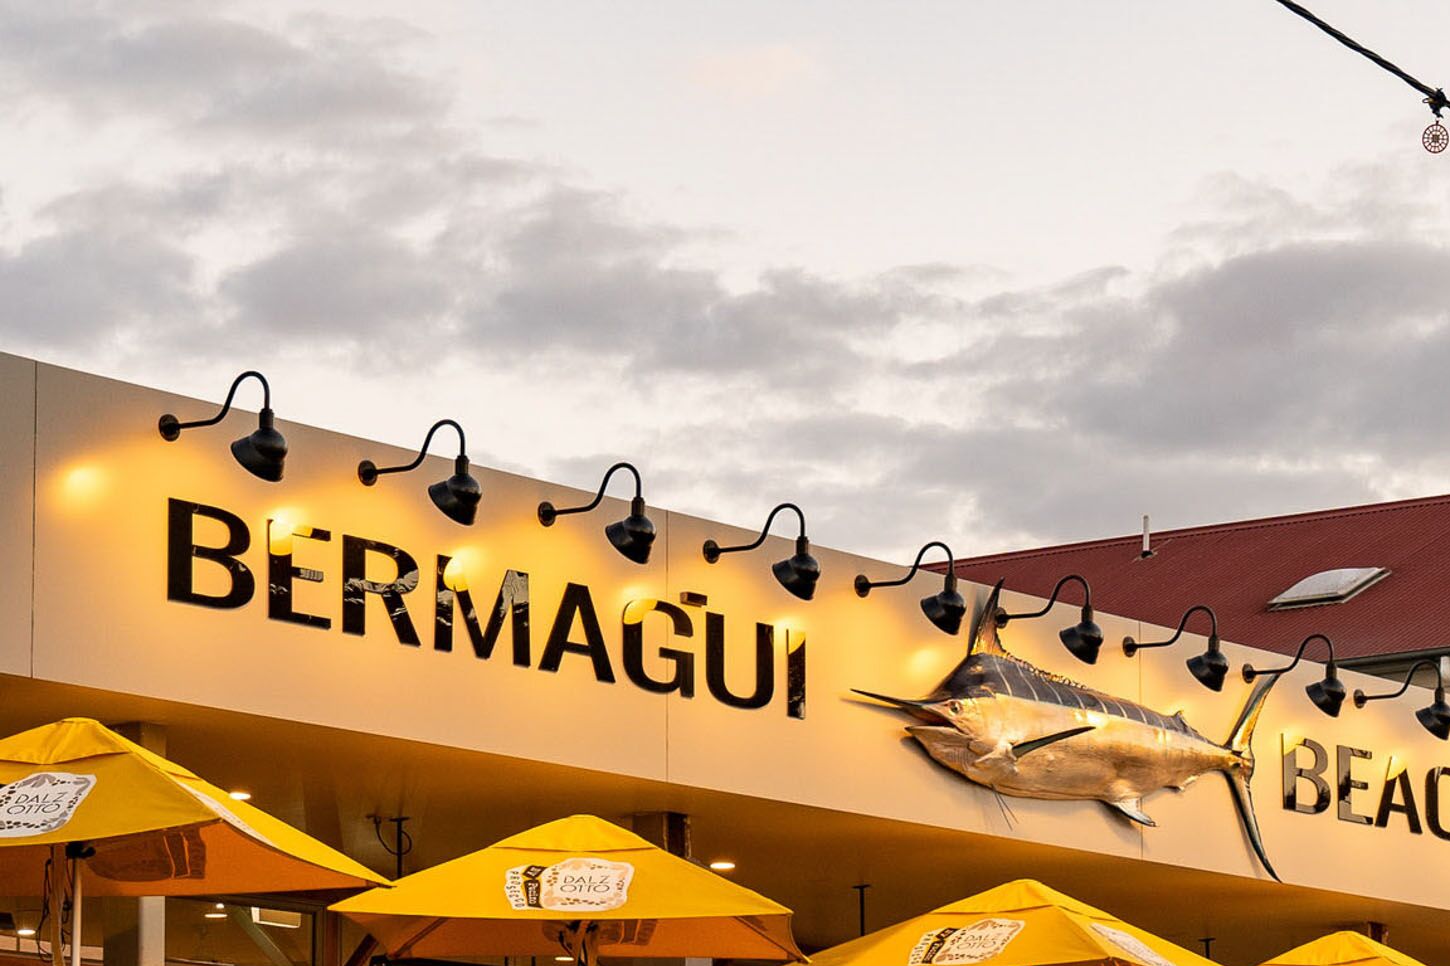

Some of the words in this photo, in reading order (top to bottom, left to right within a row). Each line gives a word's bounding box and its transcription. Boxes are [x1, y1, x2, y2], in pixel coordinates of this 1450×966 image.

[167, 496, 807, 720] BERMAGUI
[15, 791, 68, 804] DALZ
[7, 803, 61, 815] OTTO
[563, 875, 610, 884] DALZ
[560, 884, 610, 893] OTTO
